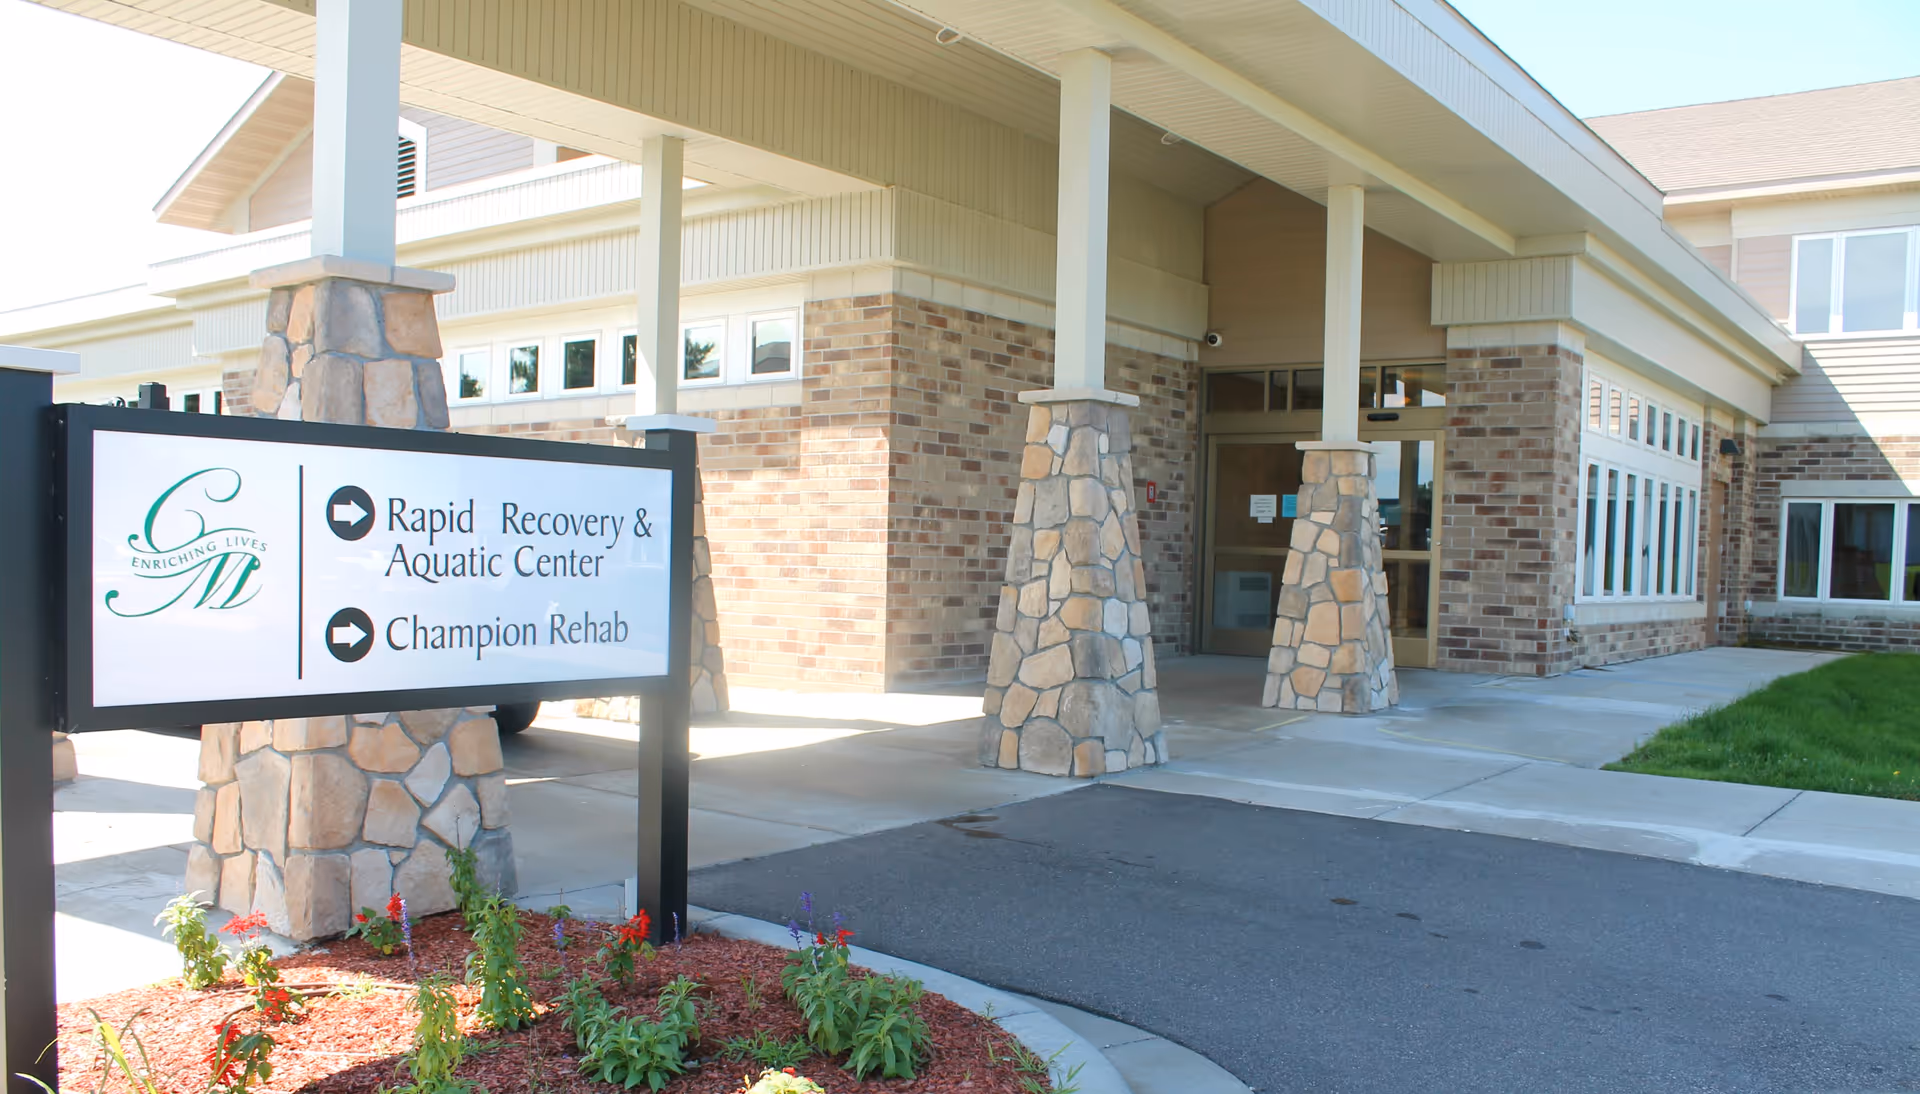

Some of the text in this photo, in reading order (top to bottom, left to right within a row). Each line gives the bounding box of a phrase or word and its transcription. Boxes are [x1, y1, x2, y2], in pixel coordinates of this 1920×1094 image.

[388, 498, 652, 550] Rapid Recovery &
[131, 536, 268, 570] ENRICHING LIVES
[385, 543, 604, 583] Aquatic Center
[386, 610, 629, 660] Champion Rehab
